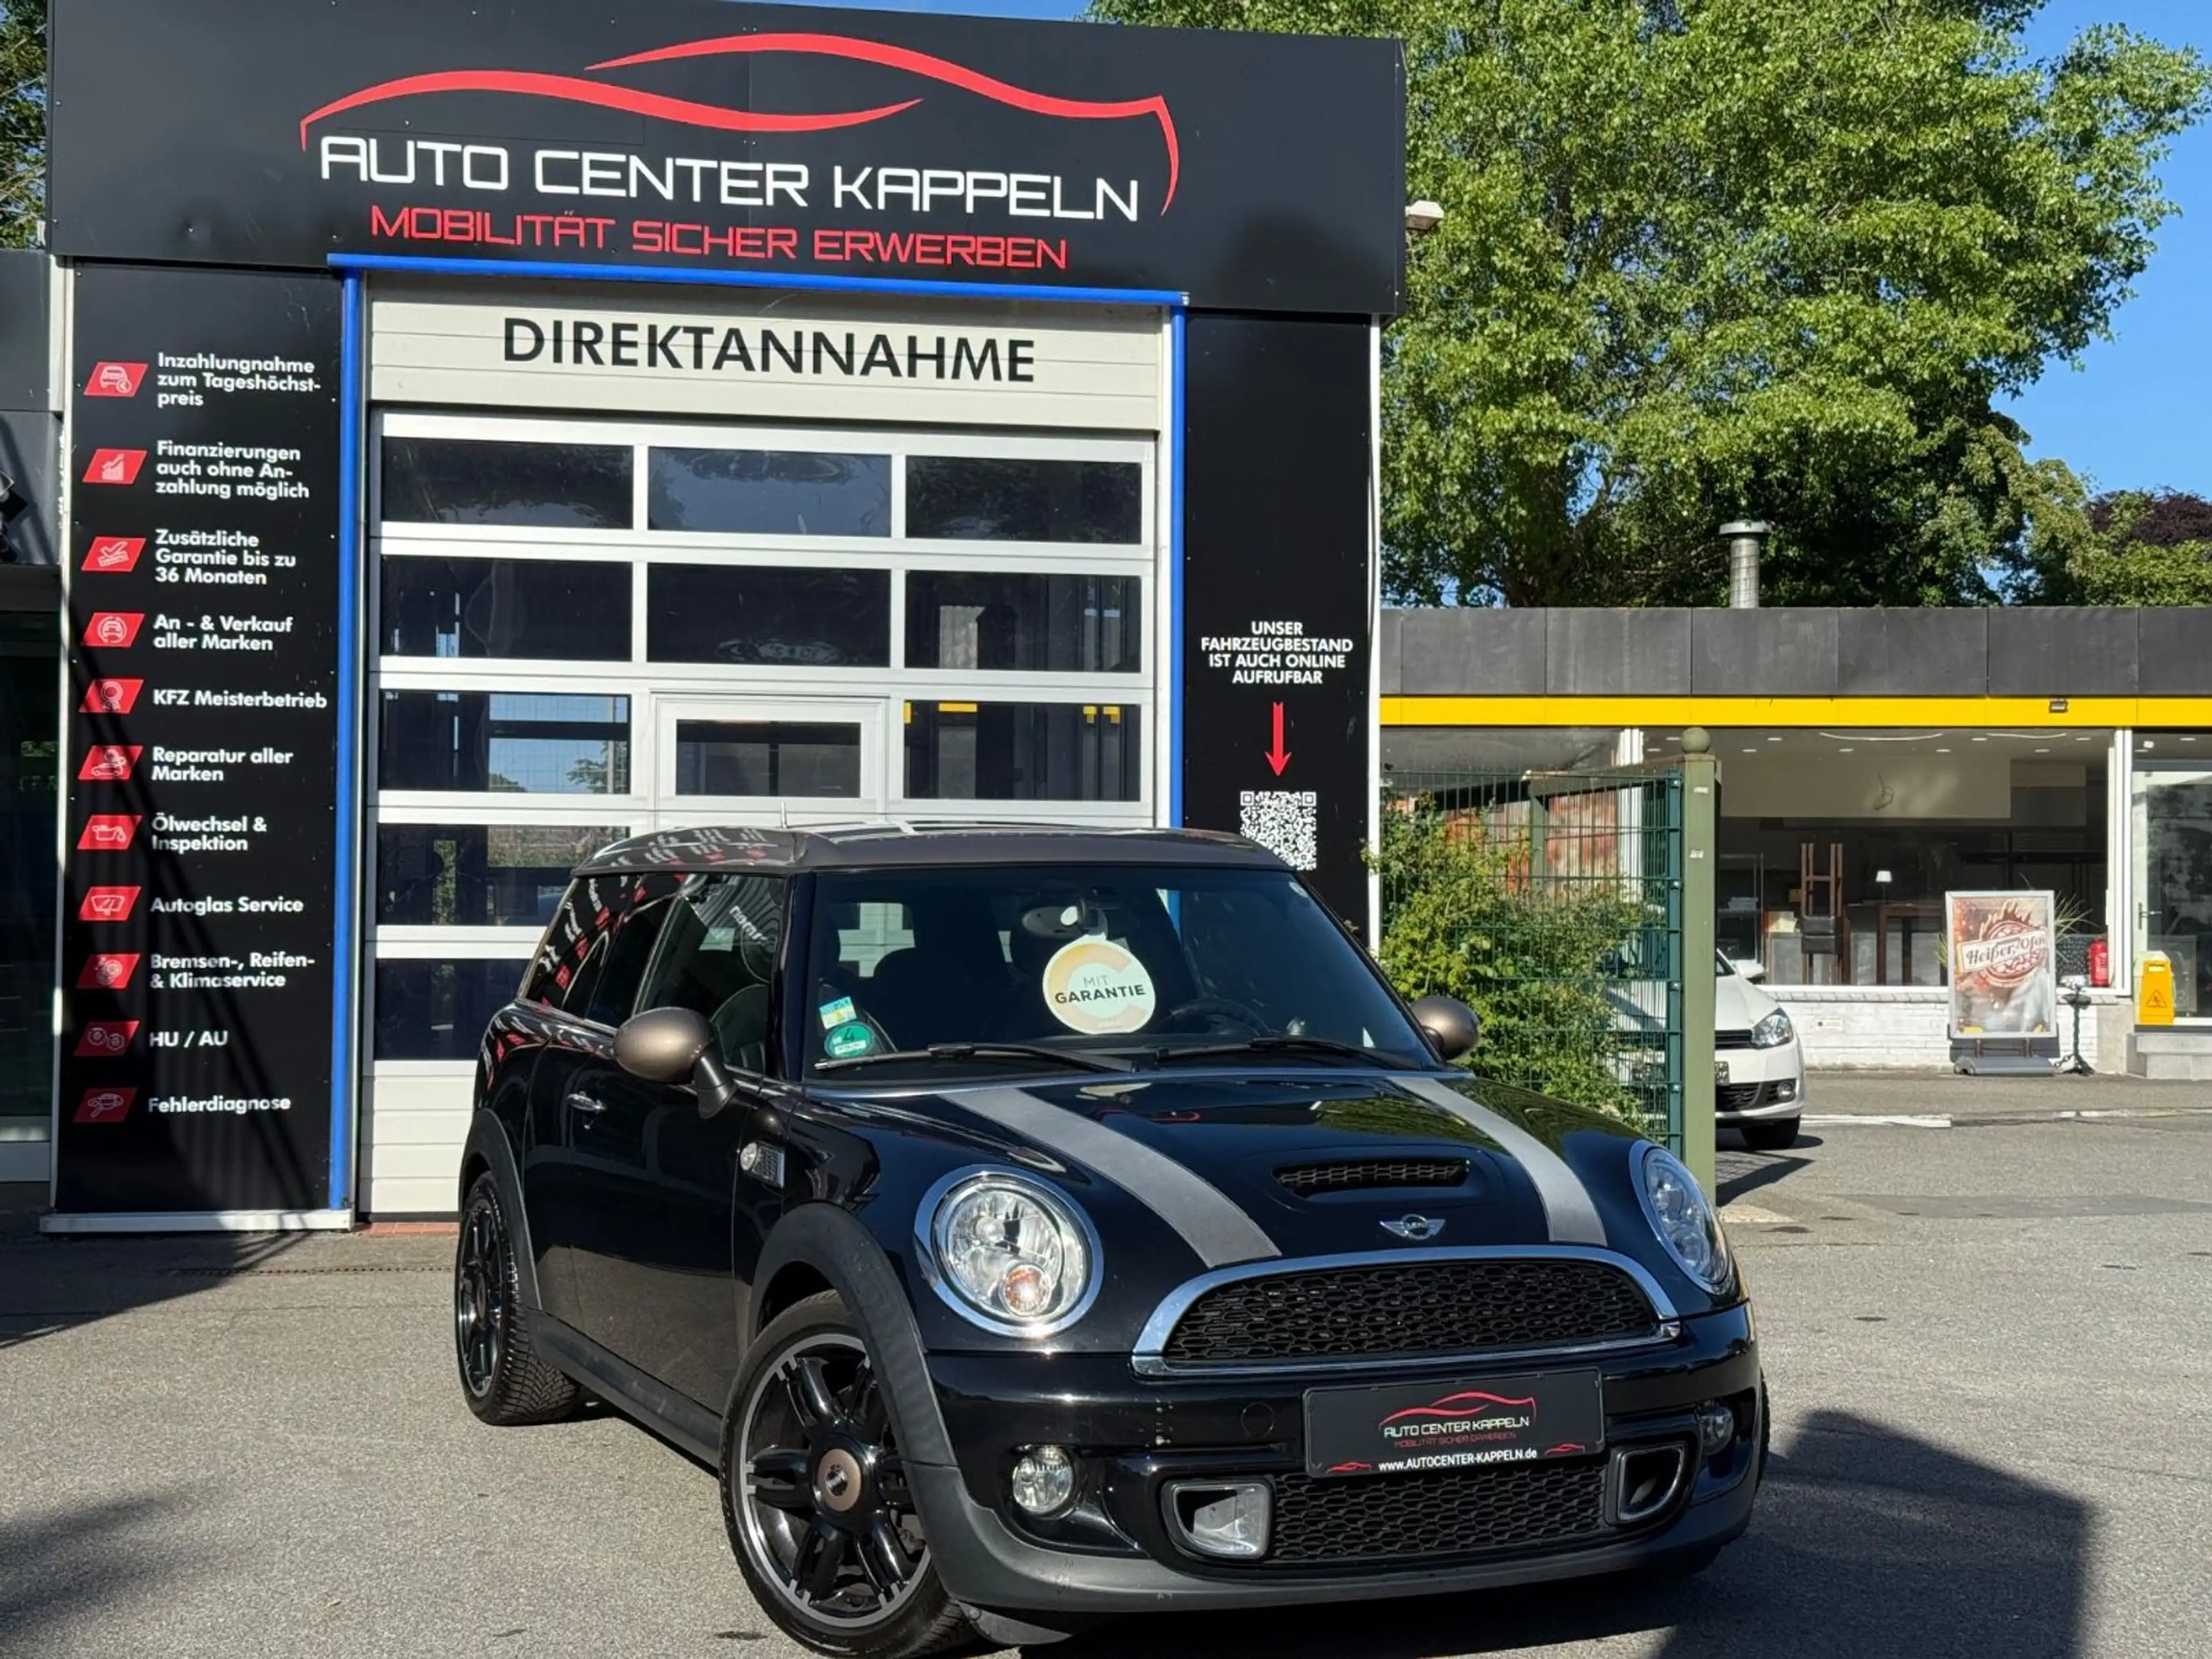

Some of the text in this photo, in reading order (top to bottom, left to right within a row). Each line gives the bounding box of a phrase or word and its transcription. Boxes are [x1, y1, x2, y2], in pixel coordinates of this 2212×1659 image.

[321, 135, 1138, 222] AUTO CENTER KAPPELN
[370, 205, 1067, 268] MOBILITÄT SICHER ERWERBEN
[505, 317, 1035, 382] DIREKTANNAHME
[157, 351, 315, 375] Inzahlungnahme
[156, 372, 321, 393] zum Tageshöchst-
[157, 389, 204, 409] preis
[157, 439, 301, 464] Finanzierungen
[156, 459, 293, 479] auch ohne An-
[155, 477, 310, 501] zahlung möglich
[155, 528, 260, 548] Zusätzliche
[155, 547, 297, 567] Garantie bis zu
[154, 566, 267, 585] 36 Monaten
[153, 613, 181, 630] An
[199, 615, 215, 631] &
[219, 615, 294, 632] Verkauf
[1251, 620, 1304, 636] UNSER
[153, 631, 274, 651] aller Marken
[1200, 637, 1354, 653] FAHRZEUGBESTAND
[1209, 653, 1346, 669] IST AUCH ONLINE
[1232, 669, 1323, 684] AUFRUFBAR
[153, 688, 328, 709] KFZ Meisterbetrieb
[152, 745, 294, 766] Reparatur aller
[151, 764, 224, 782] Marken
[152, 812, 267, 832] Ölwechsel &
[152, 834, 248, 855] Inspektion
[151, 895, 304, 916] Autoglas Service
[151, 950, 315, 971] Bremsen-, Reifen-
[150, 970, 287, 988] & Klimaservice
[1084, 975, 1108, 987] MIT
[1054, 984, 1146, 1003] GARANTIE
[150, 1031, 179, 1047] HU
[198, 1030, 228, 1047] AU
[149, 1094, 291, 1115] Fehlerdiagnose
[1384, 1416, 1529, 1438] AUTO CENTER KAPPELN
[1378, 1448, 1538, 1471] www.AUTOCENTER-KAPPELN.de
